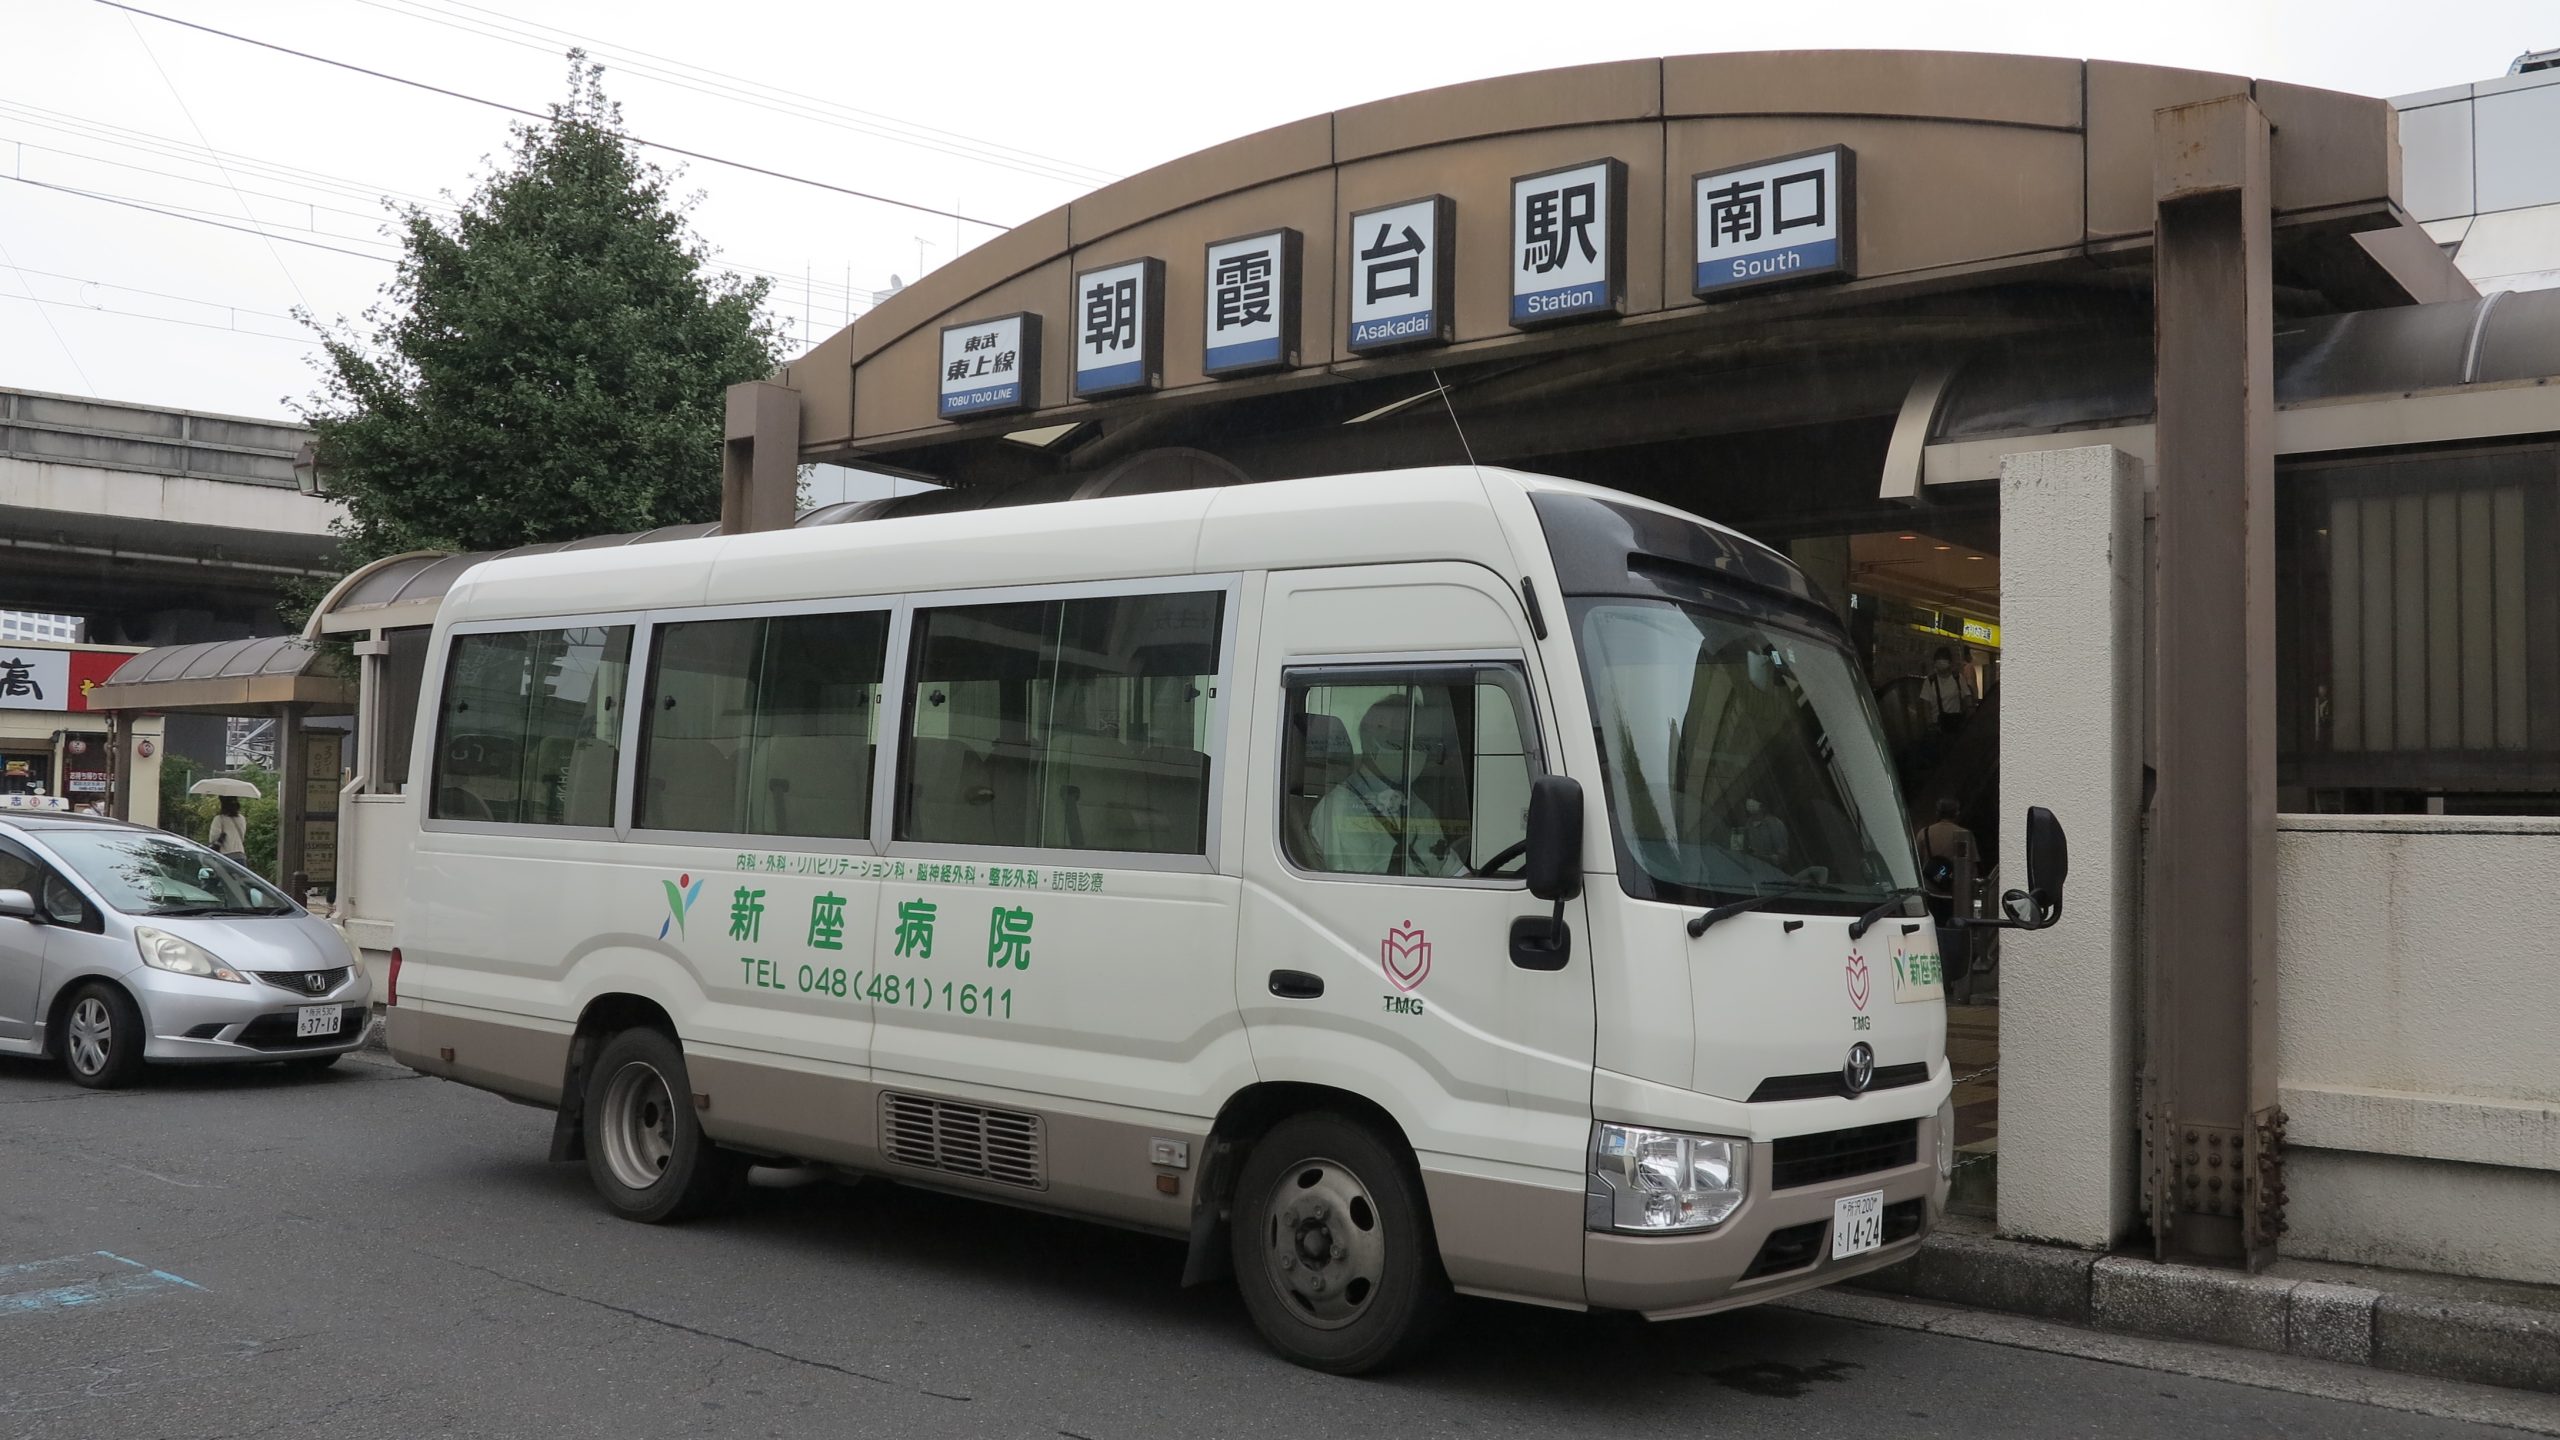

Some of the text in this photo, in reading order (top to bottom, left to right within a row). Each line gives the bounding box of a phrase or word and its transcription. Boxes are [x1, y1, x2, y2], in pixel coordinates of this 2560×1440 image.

[1707, 167, 1826, 250] 南口
[1522, 181, 1598, 275] 駅
[1361, 223, 1426, 305] 台
[1731, 250, 1801, 278] South
[1216, 249, 1273, 332] 霞
[1526, 286, 1594, 314] Station
[1085, 277, 1137, 355] 朝
[1355, 314, 1429, 342] Asakadai
[964, 333, 999, 353] 東武
[946, 350, 1016, 382] 東上線
[948, 388, 1013, 407] TOBU TOJO LINE
[729, 885, 1035, 971] 新座病院
[741, 957, 1013, 1019] TEL 048(481)1611
[1383, 995, 1424, 1016] TMG
[307, 1016, 339, 1034] 37-18
[1852, 1016, 1871, 1031] TMG
[1846, 1214, 1880, 1252] 14-24
